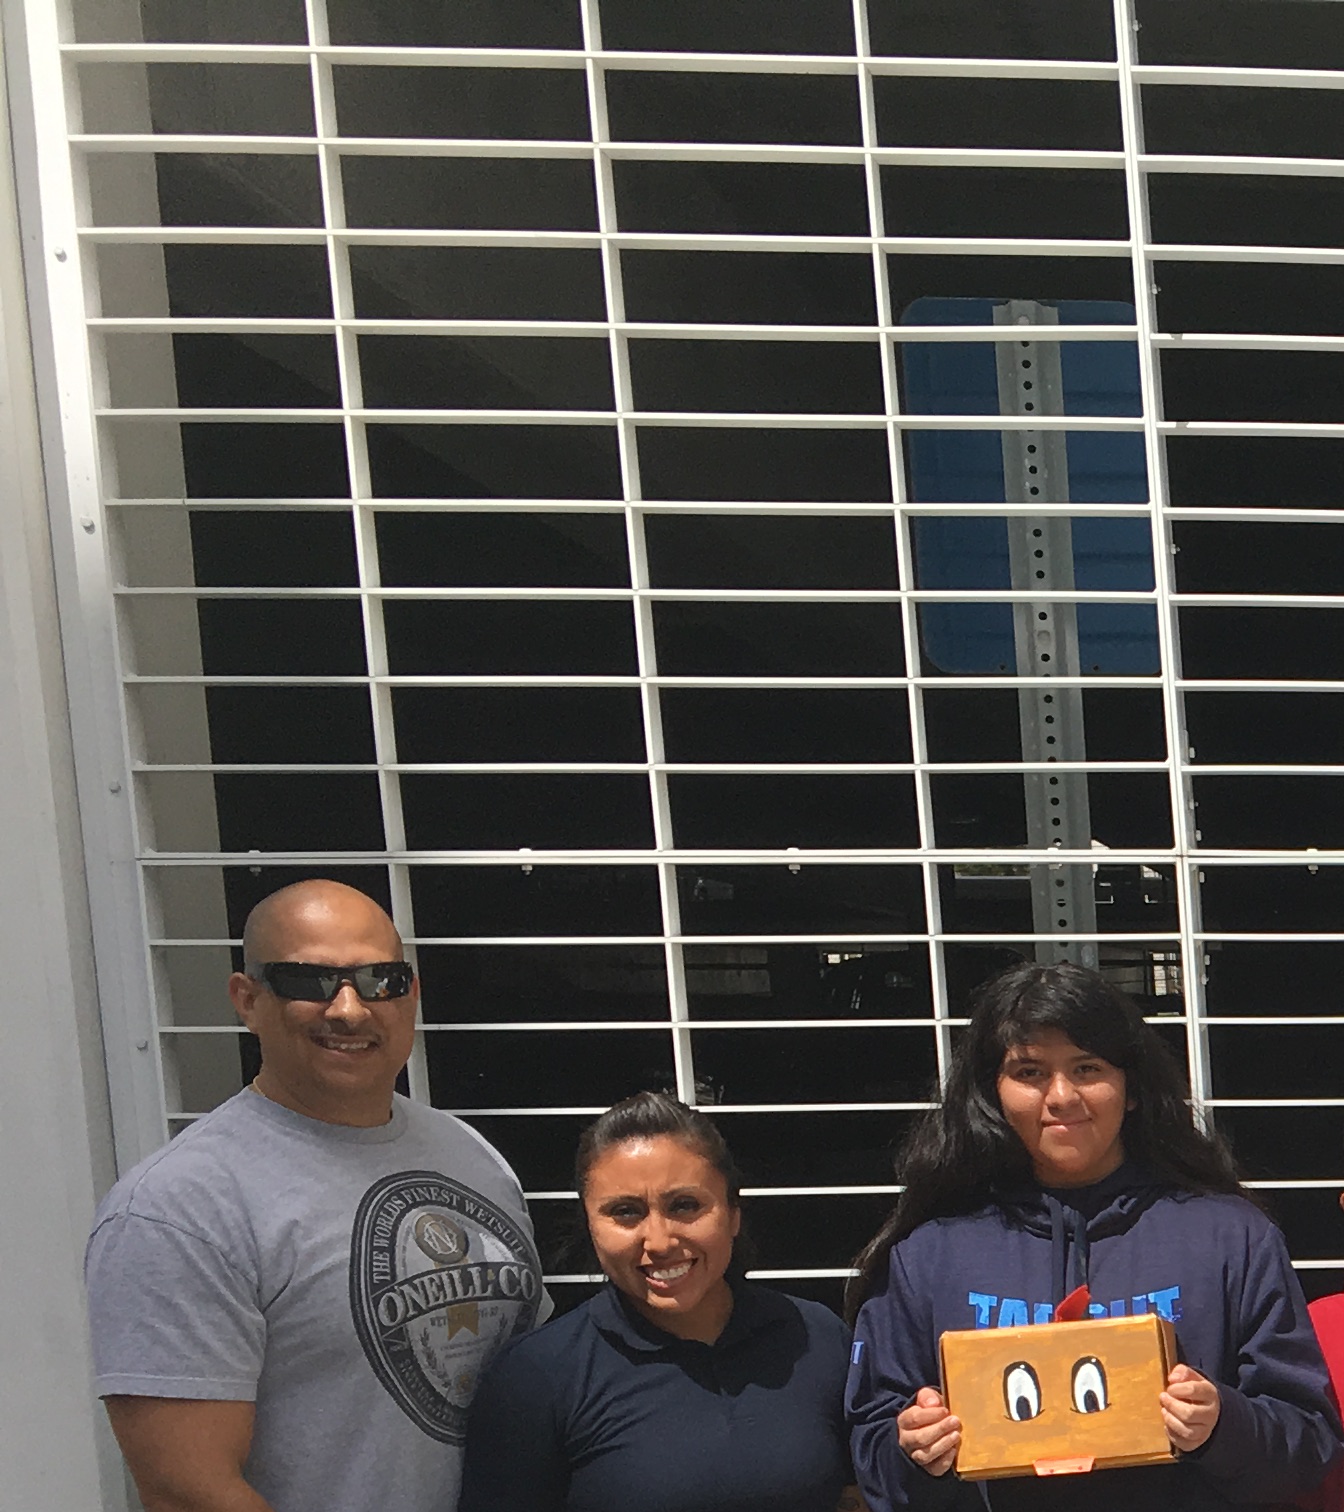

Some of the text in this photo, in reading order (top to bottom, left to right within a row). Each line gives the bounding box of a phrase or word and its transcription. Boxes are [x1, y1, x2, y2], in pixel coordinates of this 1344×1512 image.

[404, 1186, 461, 1209] FINEST
[374, 1195, 407, 1250] WORLDS
[373, 1252, 391, 1284] THE
[377, 1266, 493, 1327] O'NEILL
[499, 1265, 536, 1300] CO
